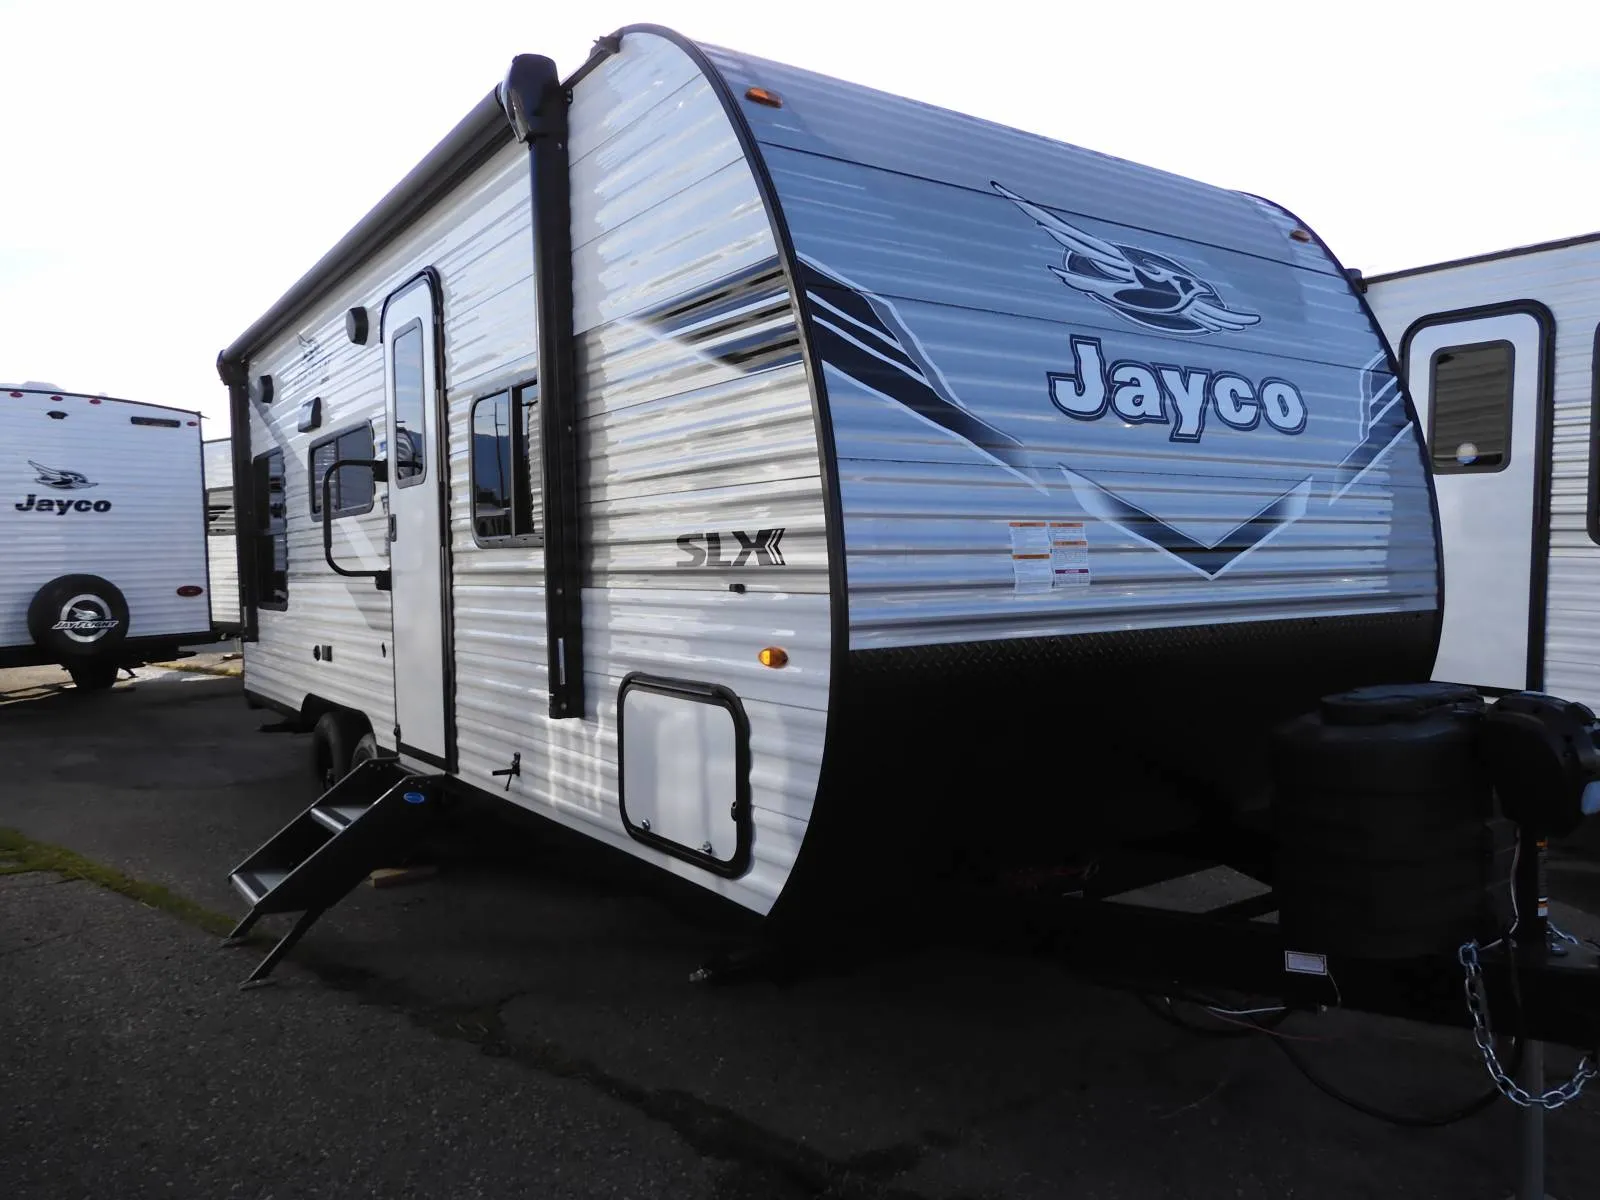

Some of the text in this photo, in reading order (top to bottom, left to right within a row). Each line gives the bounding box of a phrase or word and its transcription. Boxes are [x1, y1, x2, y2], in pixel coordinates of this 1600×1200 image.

[1046, 333, 1308, 443] Jayco
[15, 494, 112, 516] Jayco
[676, 528, 785, 567] SLX
[54, 620, 77, 630] JAY
